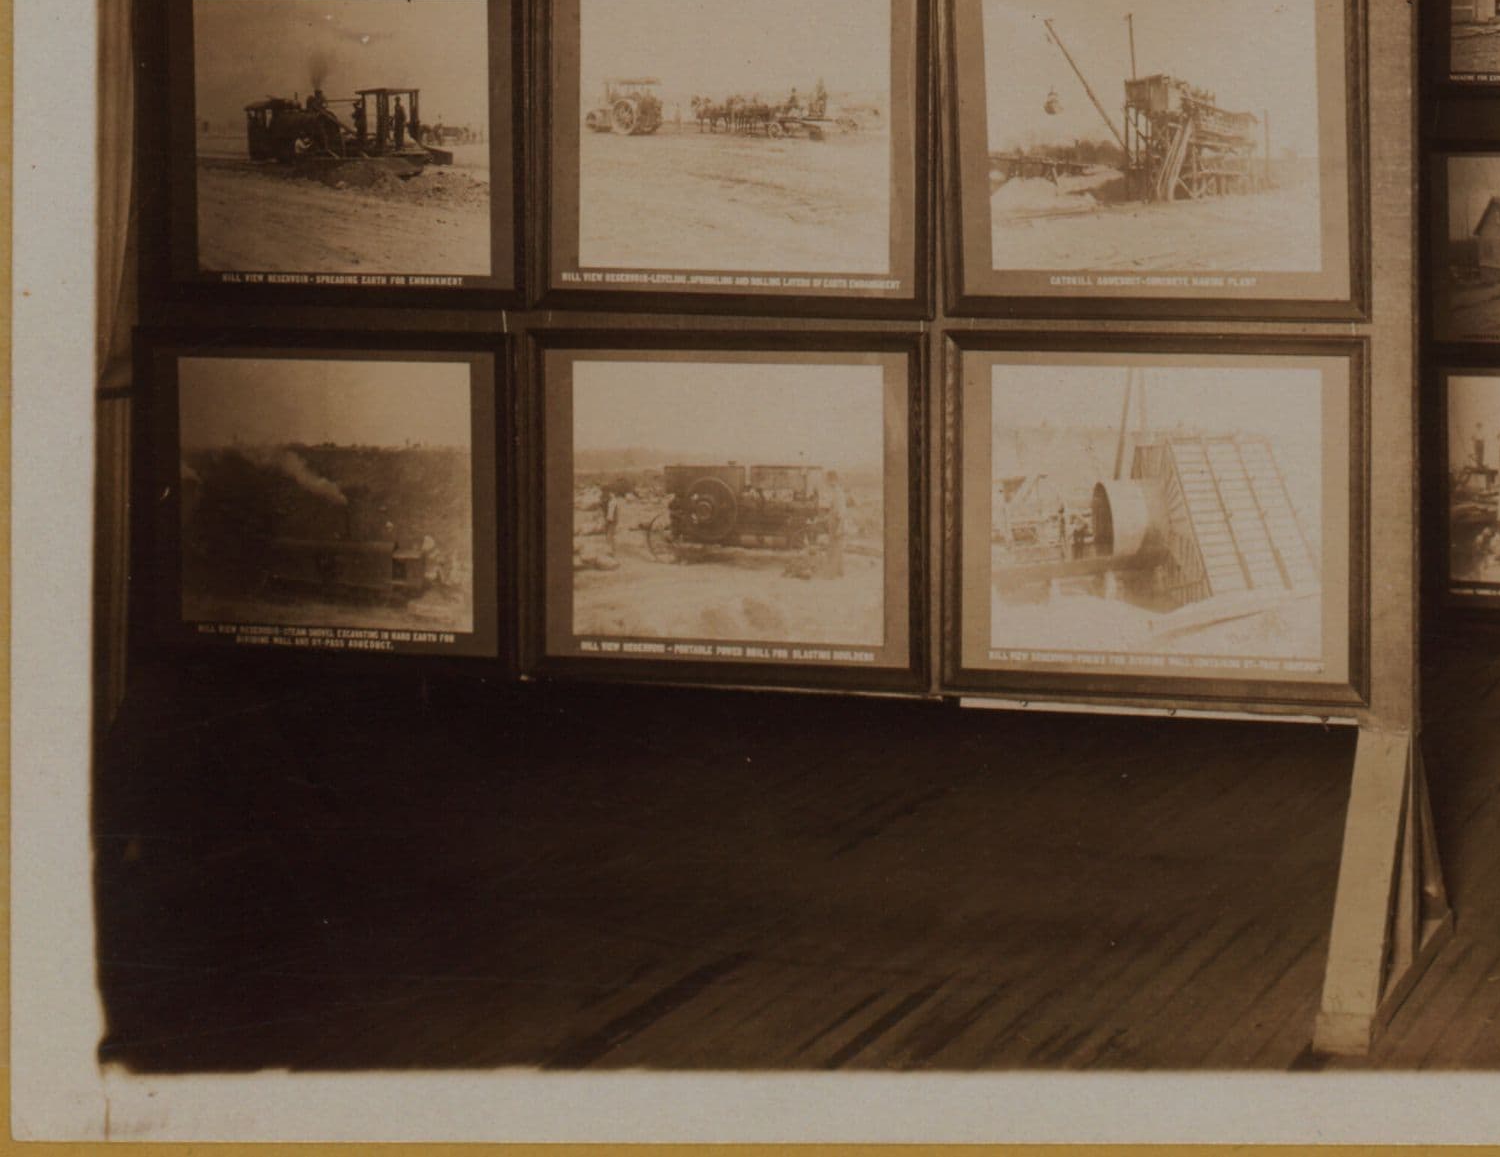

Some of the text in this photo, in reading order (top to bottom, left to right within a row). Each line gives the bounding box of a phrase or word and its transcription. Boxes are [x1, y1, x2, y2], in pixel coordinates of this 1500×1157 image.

[222, 274, 241, 284] HILL
[245, 274, 264, 284] VIEW
[390, 276, 406, 286] FOR
